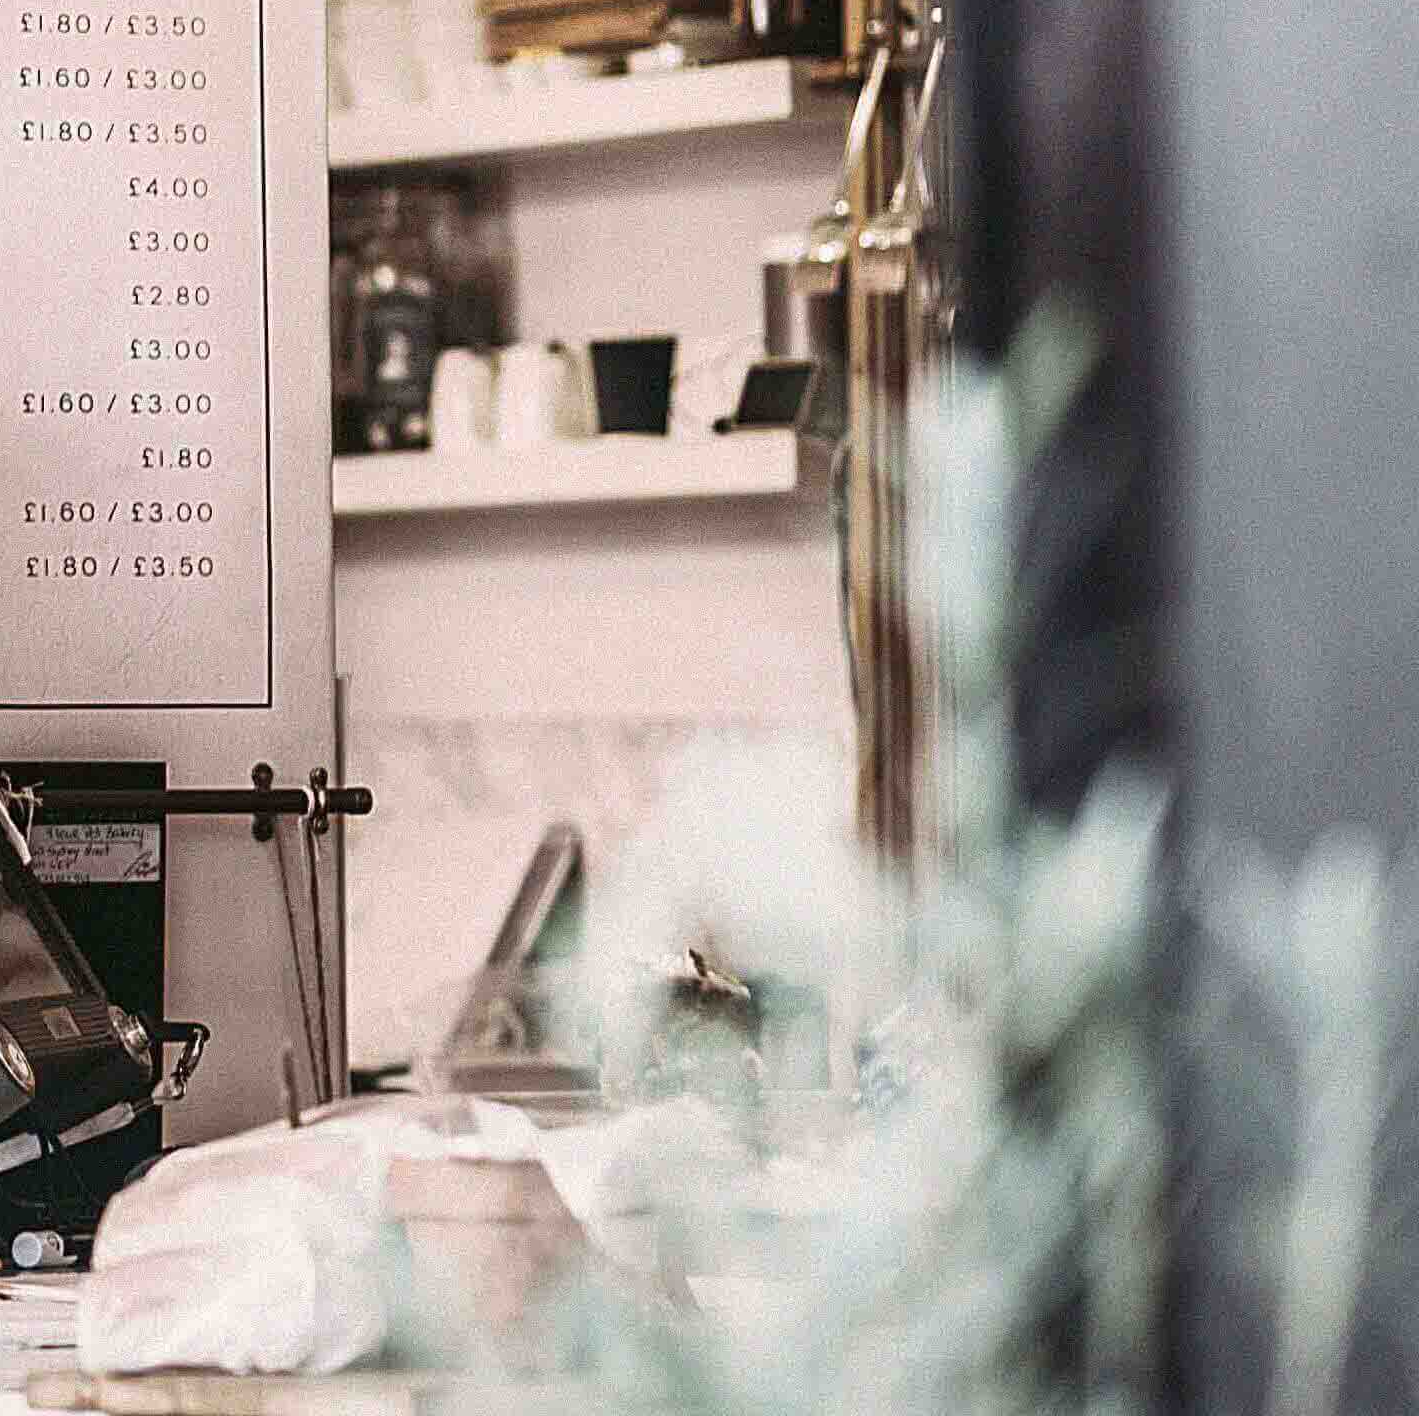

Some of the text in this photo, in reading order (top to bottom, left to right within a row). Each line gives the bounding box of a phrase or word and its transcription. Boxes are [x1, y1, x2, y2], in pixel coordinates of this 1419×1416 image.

[20, 11, 92, 35] £1.80
[126, 14, 206, 38] £3.50
[18, 65, 91, 89] £1.60
[125, 68, 207, 91] £3.00
[21, 119, 94, 143] £1.80
[127, 122, 208, 145] £3.50
[128, 176, 209, 200] £4.00
[128, 230, 210, 253] £3.00
[131, 284, 211, 307] £2.80
[129, 337, 212, 361] £3.00
[22, 391, 95, 415] £1.60
[129, 392, 212, 415] £3.00
[141, 446, 213, 470] £1.80
[23, 500, 96, 524] £1.60
[131, 500, 214, 524] £3.00
[25, 554, 98, 579] £1.80
[133, 555, 214, 579] £3.50
